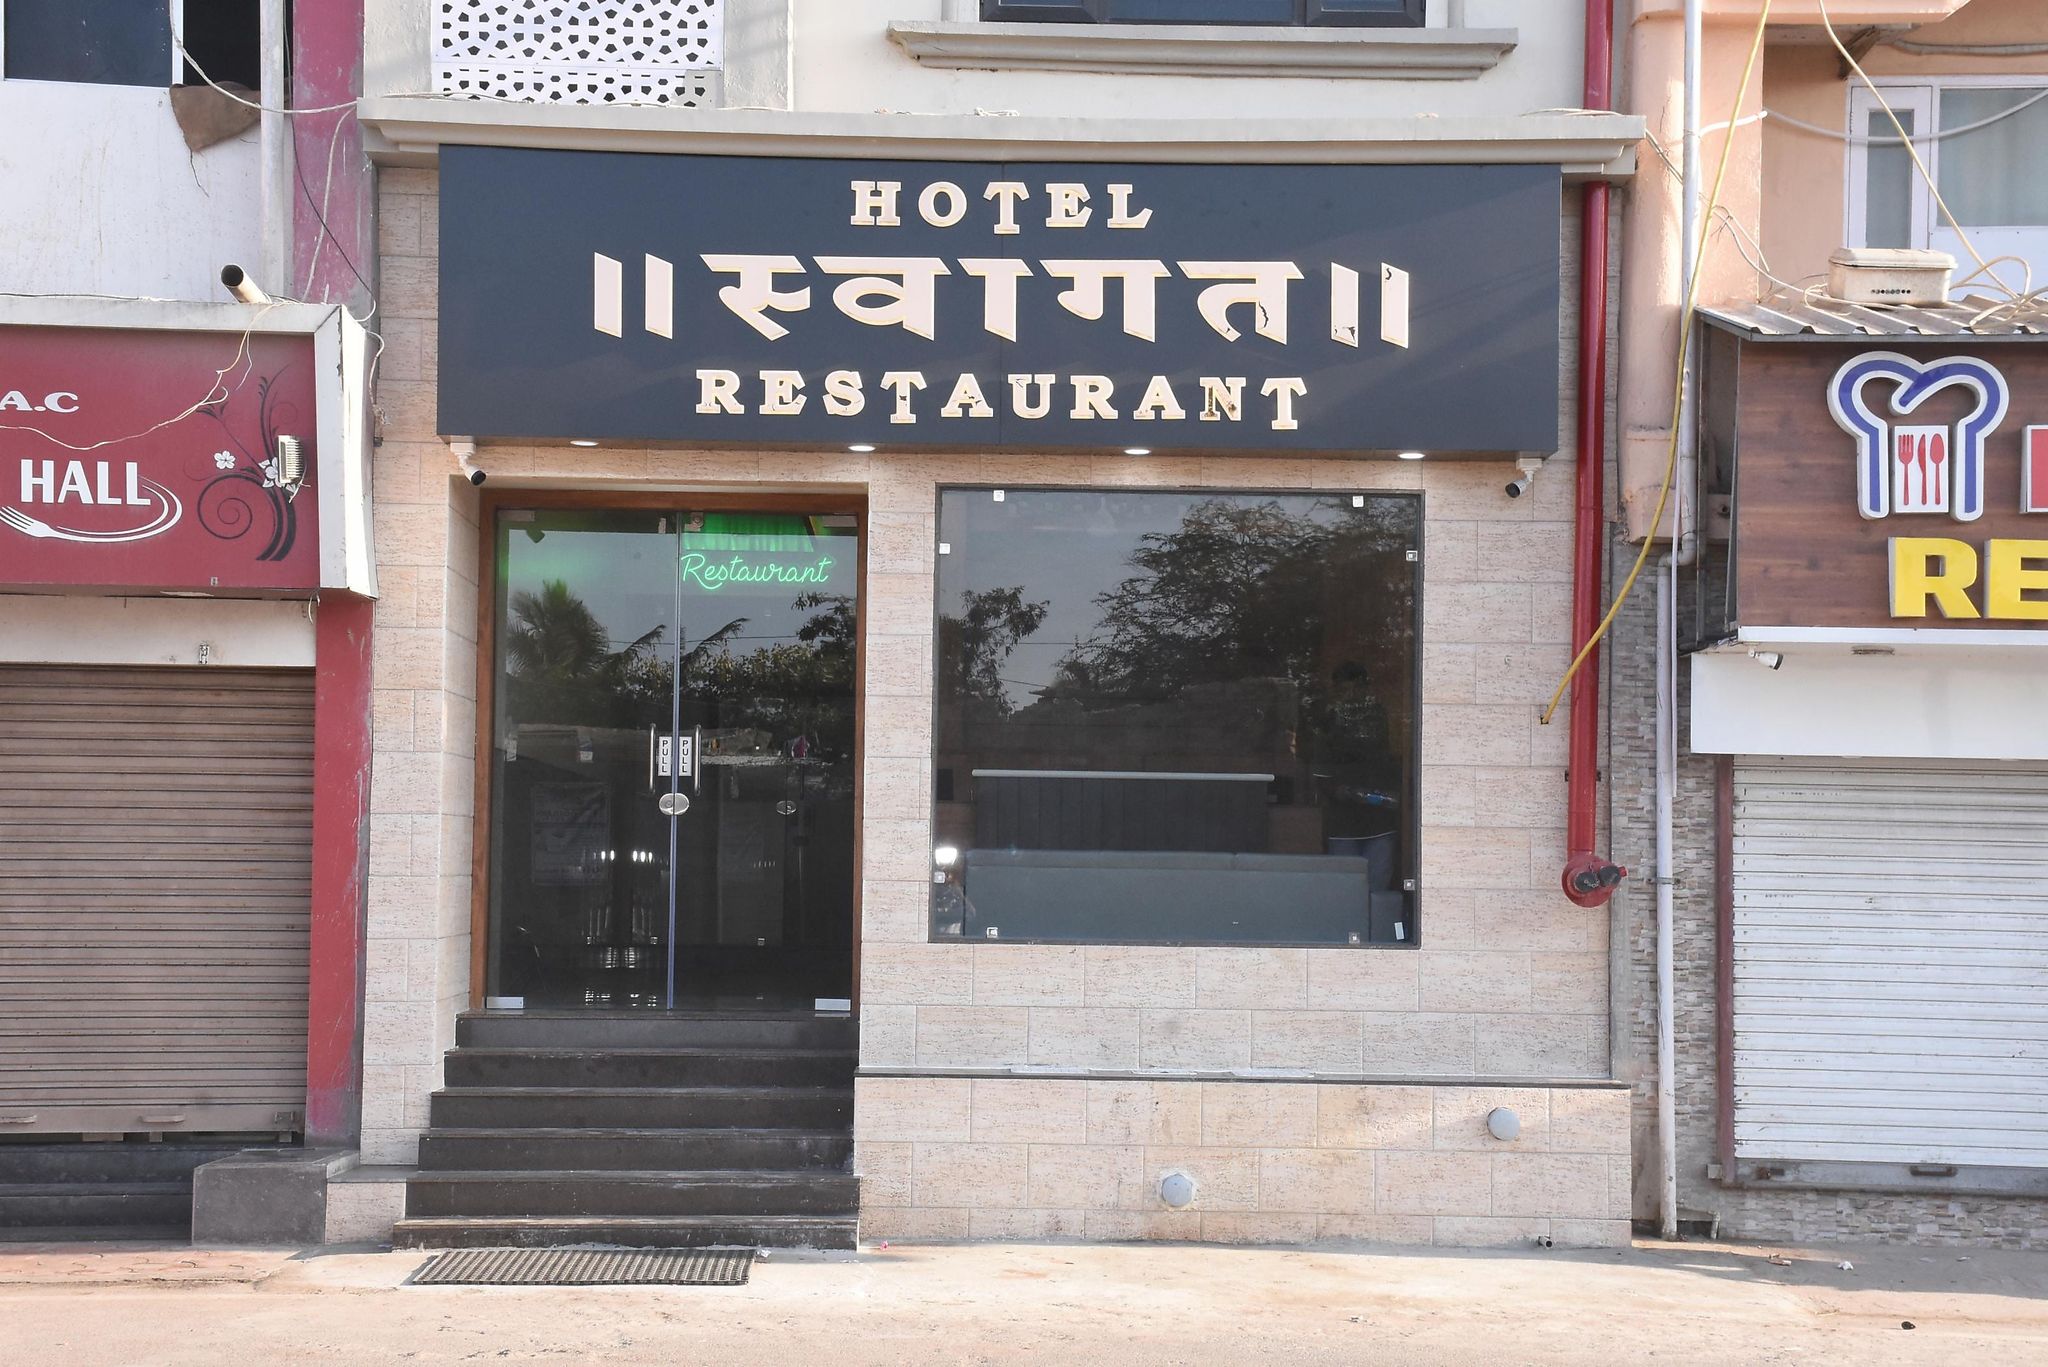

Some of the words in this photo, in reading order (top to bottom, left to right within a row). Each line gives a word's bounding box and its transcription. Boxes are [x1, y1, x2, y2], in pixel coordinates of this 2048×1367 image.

[850, 180, 1154, 235] HOTEL
[695, 369, 1308, 430] RESTAURANT
[20, 459, 151, 506] HALL
[681, 553, 832, 590] Restaurant
[661, 739, 669, 773] PULL
[681, 739, 689, 773] PULL
